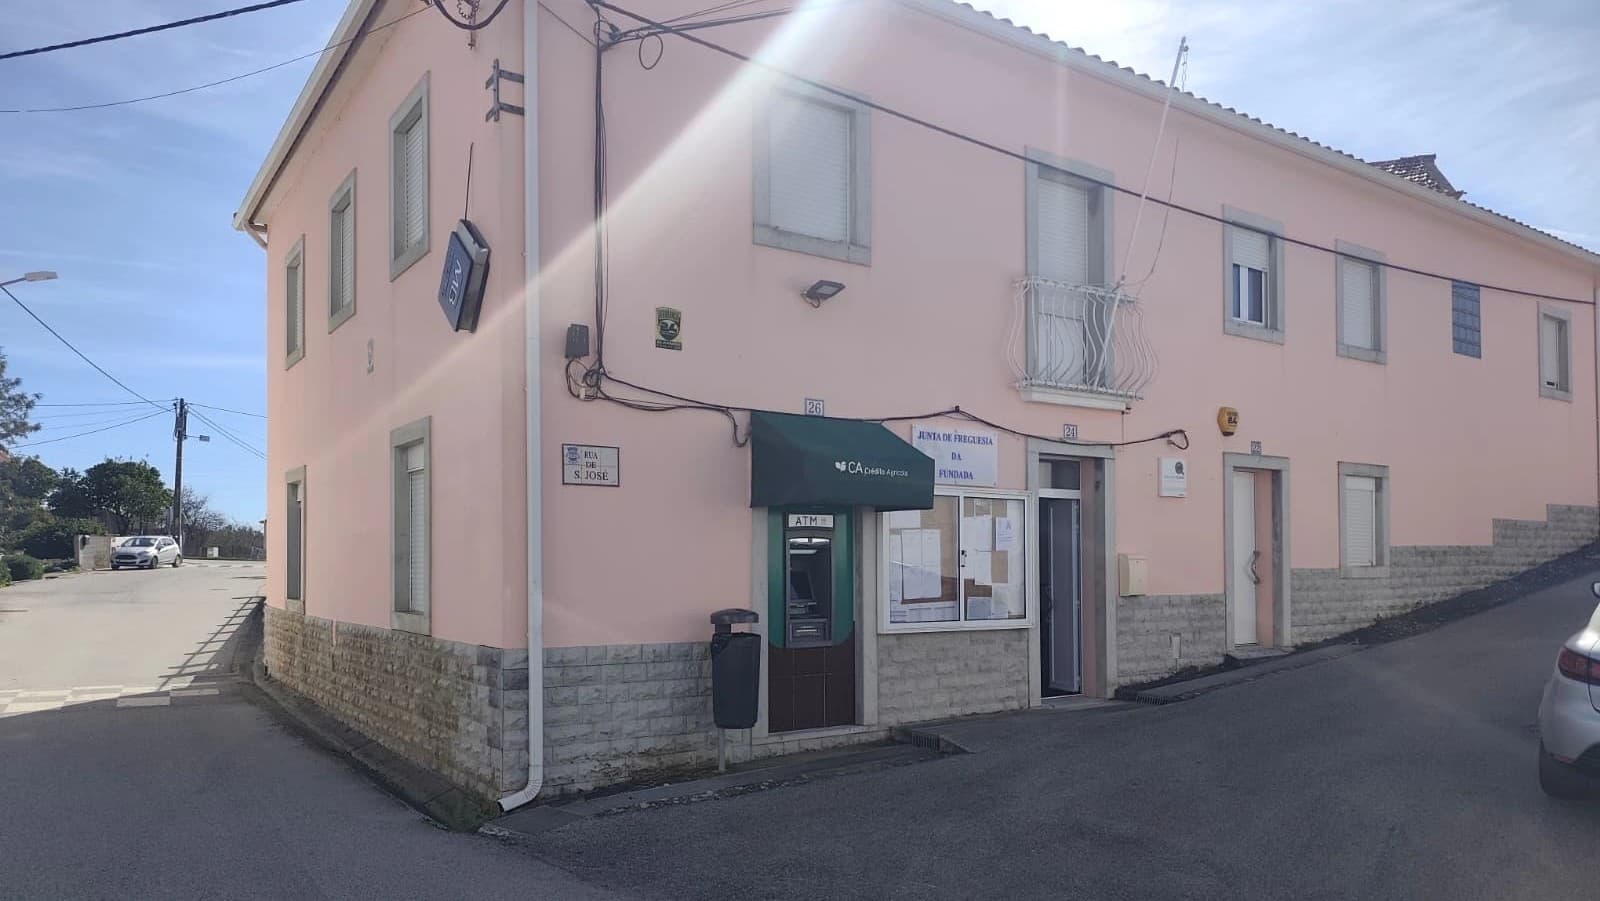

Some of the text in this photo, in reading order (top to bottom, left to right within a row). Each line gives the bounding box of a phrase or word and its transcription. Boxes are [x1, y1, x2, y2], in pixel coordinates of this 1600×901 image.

[807, 401, 822, 415] 26
[917, 430, 993, 446] JUNTA DE FREGUESIA
[584, 449, 599, 460] RUA
[951, 451, 962, 461] DA
[585, 461, 598, 469] DE
[848, 461, 863, 474] CA
[938, 468, 974, 481] FUNDADA
[795, 515, 818, 526] ATM
